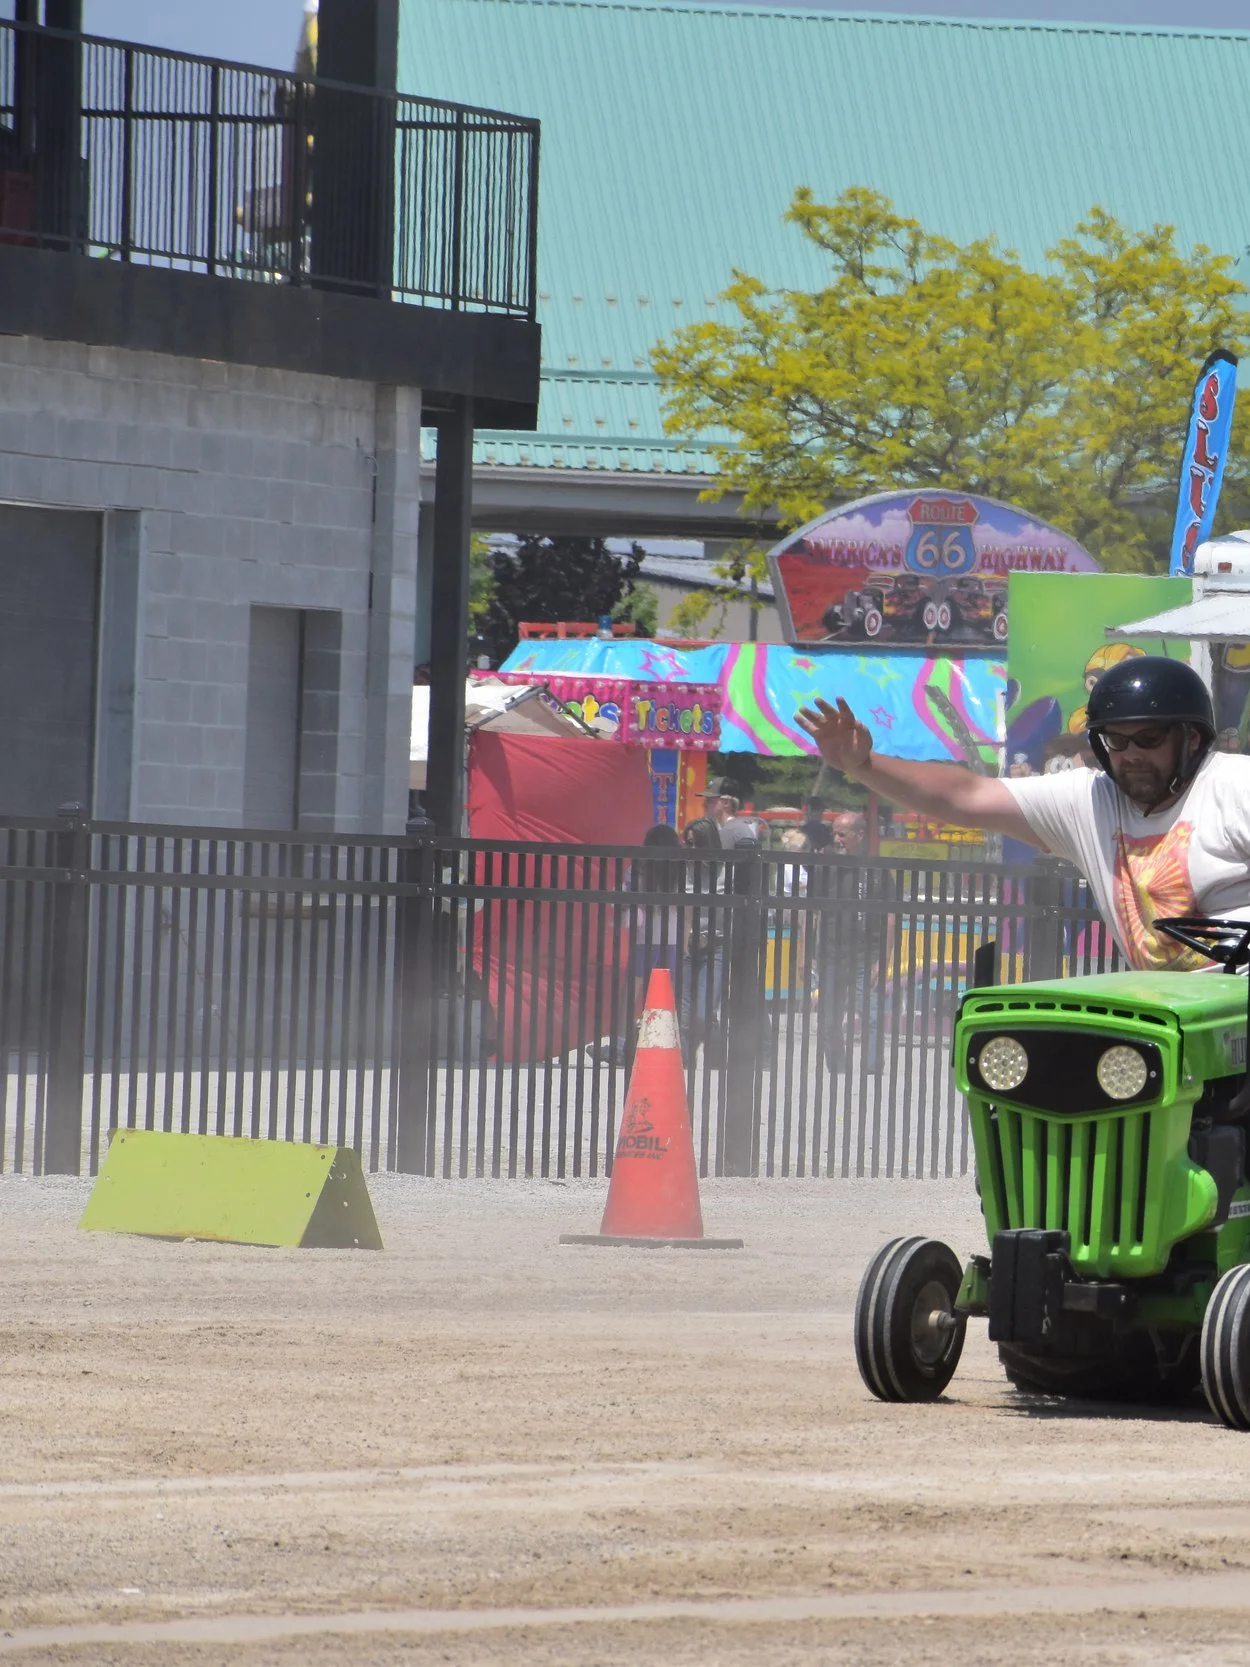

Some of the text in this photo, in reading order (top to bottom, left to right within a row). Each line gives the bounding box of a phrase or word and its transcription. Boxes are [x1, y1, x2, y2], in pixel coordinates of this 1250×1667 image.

[920, 502, 965, 521] ROUTE
[915, 530, 965, 569] 66
[980, 543, 1070, 571] HIGHWAY
[635, 699, 714, 735] Tickets
